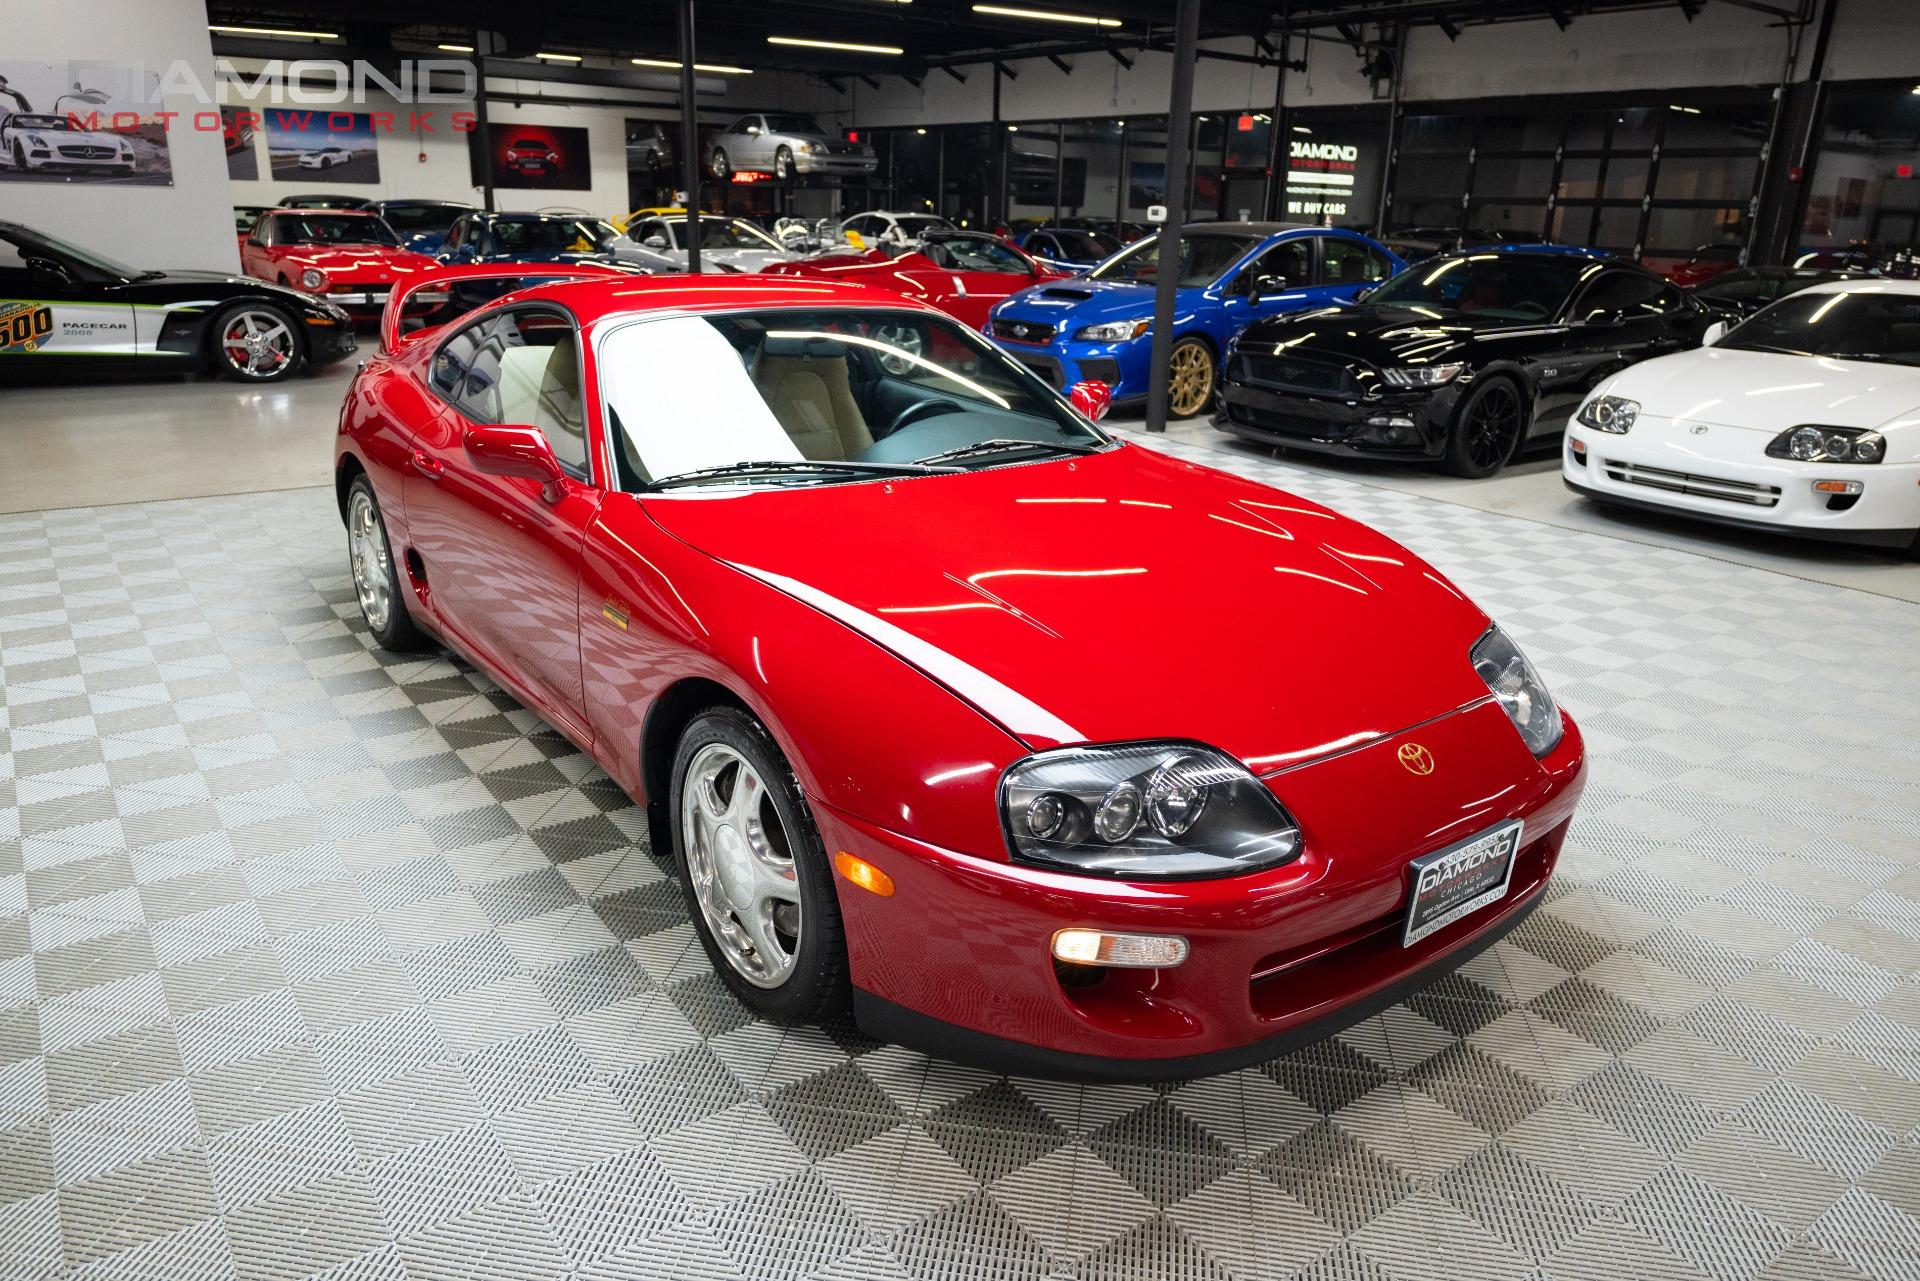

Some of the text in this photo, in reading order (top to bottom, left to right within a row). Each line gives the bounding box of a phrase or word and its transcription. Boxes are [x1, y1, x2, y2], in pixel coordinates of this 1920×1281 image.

[1288, 202, 1346, 215] WE BUY CARS
[1421, 840, 1510, 893] DIAMOND
[1441, 873, 1482, 898] CHICAGO
[1404, 888, 1506, 947] DIAMONDMOTORWORKS.COM
